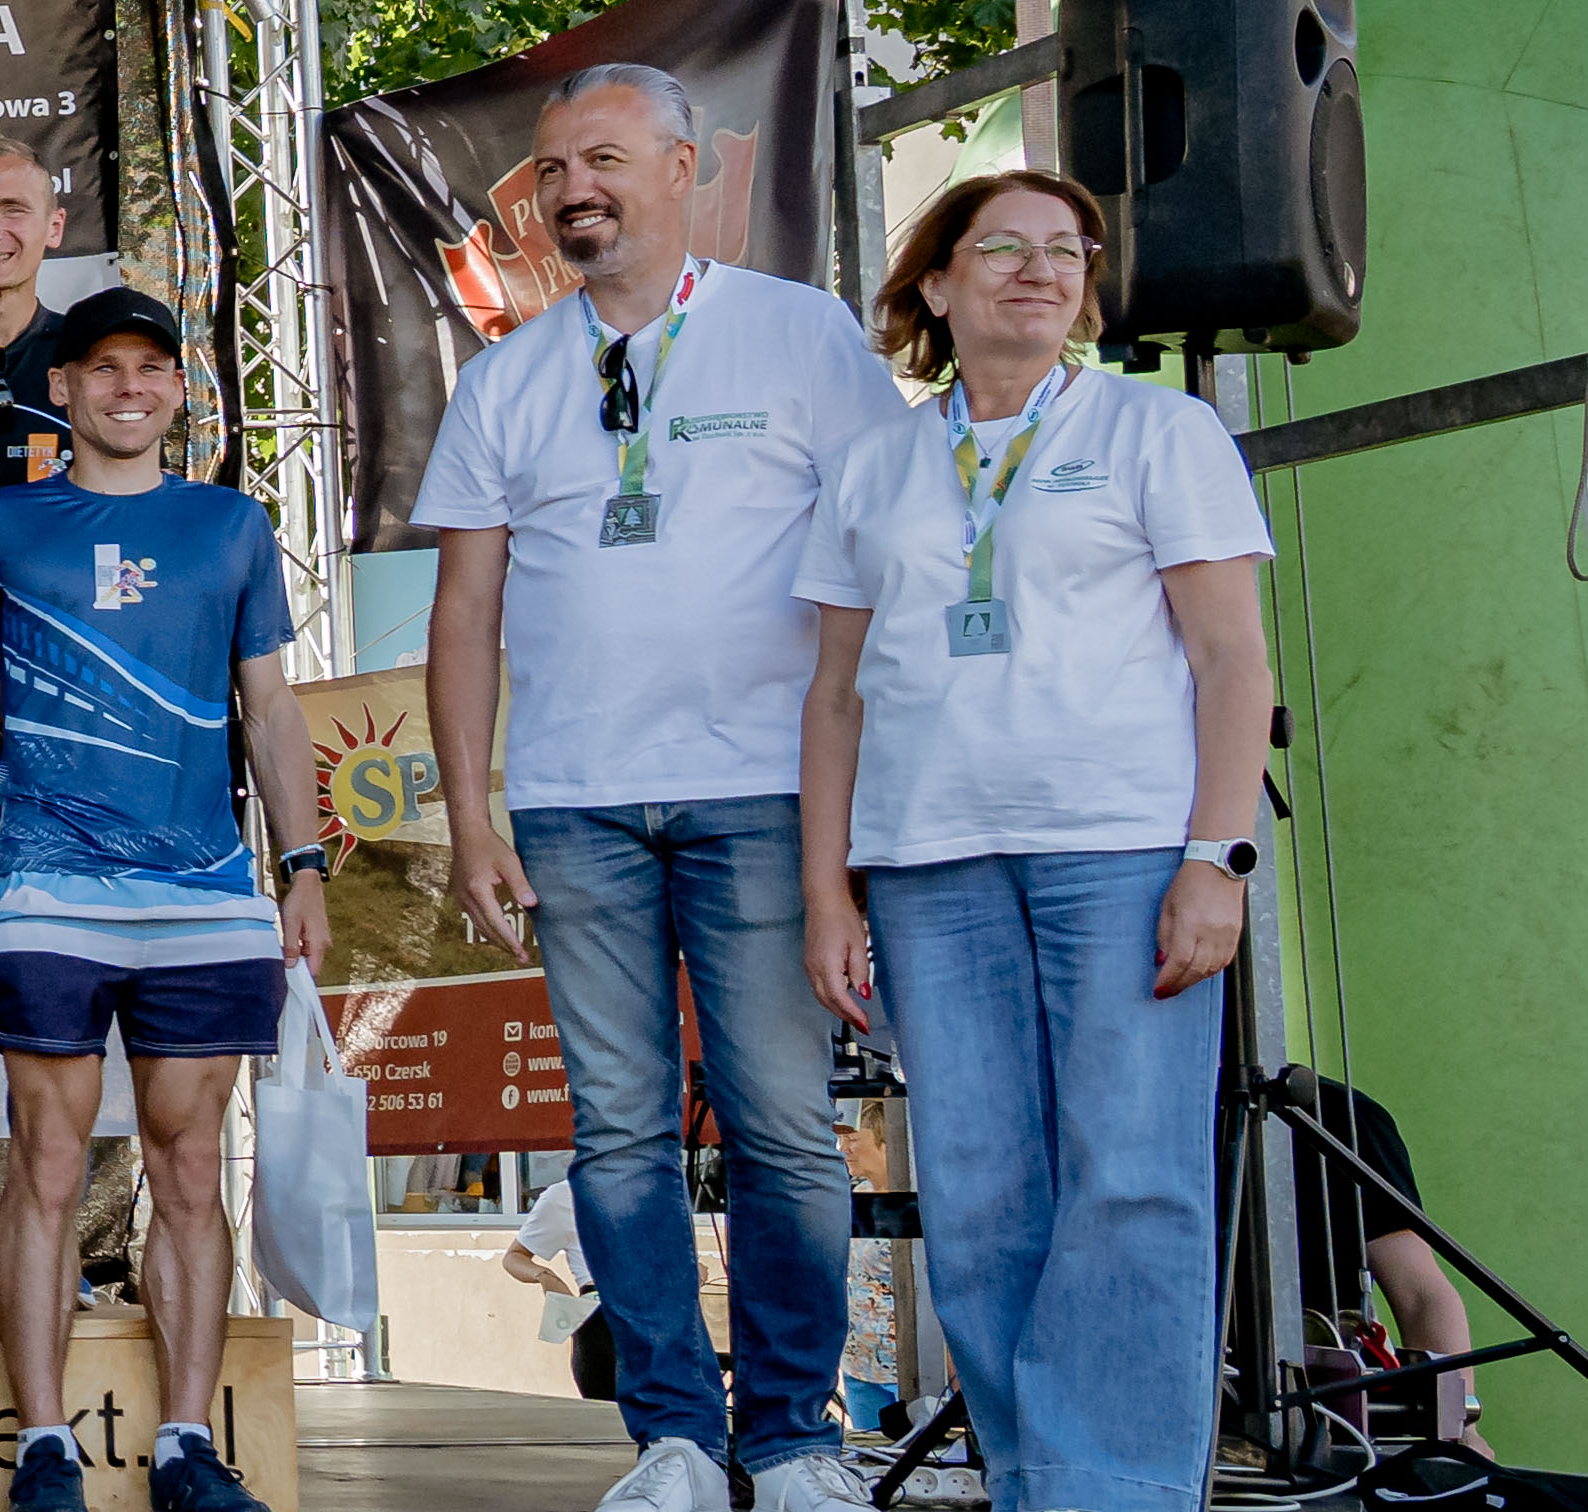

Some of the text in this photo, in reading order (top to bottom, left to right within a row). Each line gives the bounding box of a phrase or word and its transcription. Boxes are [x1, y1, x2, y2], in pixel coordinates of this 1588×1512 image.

[57, 91, 76, 117] 3
[432, 1030, 448, 1048] 19
[385, 1059, 431, 1080] Czersk
[379, 1094, 405, 1112] 506
[407, 1093, 424, 1110] 53
[428, 1092, 443, 1109] 61
